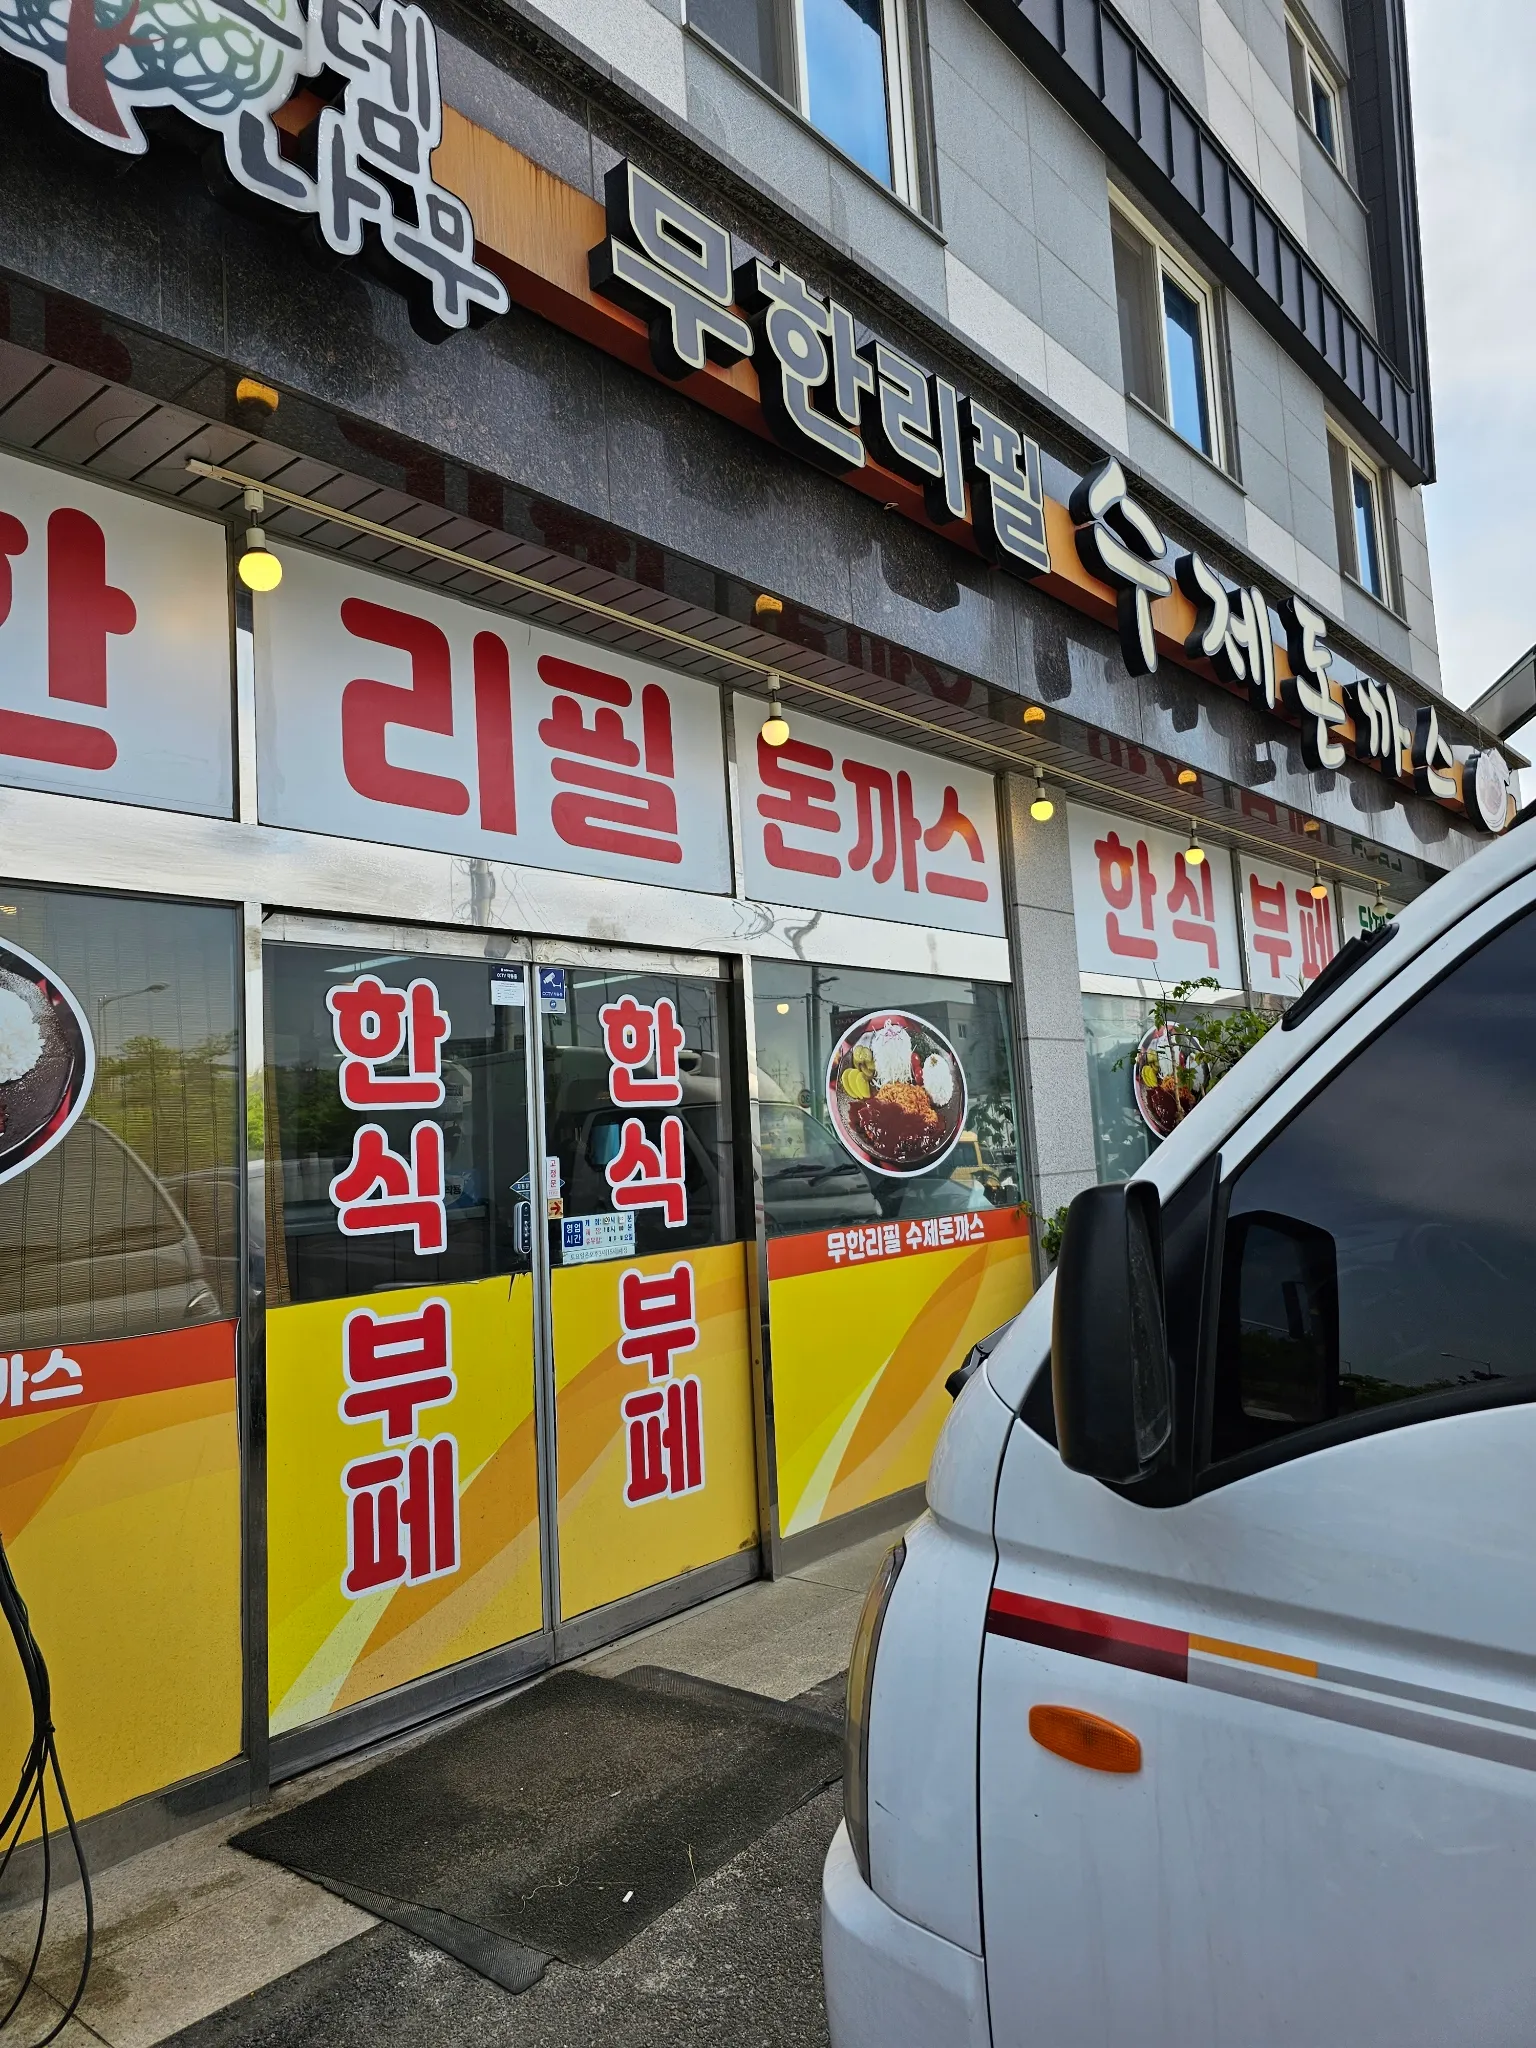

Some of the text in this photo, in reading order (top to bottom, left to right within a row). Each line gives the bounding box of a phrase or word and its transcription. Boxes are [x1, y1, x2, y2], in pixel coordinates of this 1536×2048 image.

[611, 157, 1458, 800] 무한리필 수제돈까스
[341, 597, 682, 864] 리필
[757, 729, 988, 903] 돈까스
[1094, 830, 1220, 970] 한식
[1249, 872, 1334, 980] 부페
[328, 975, 460, 1598] 한식 부페
[566, 1223, 581, 1234] 영업
[566, 1234, 581, 1245] 시간
[600, 994, 705, 1507] 한식 부페
[827, 1212, 985, 1264] 무한리필 수제돈까스
